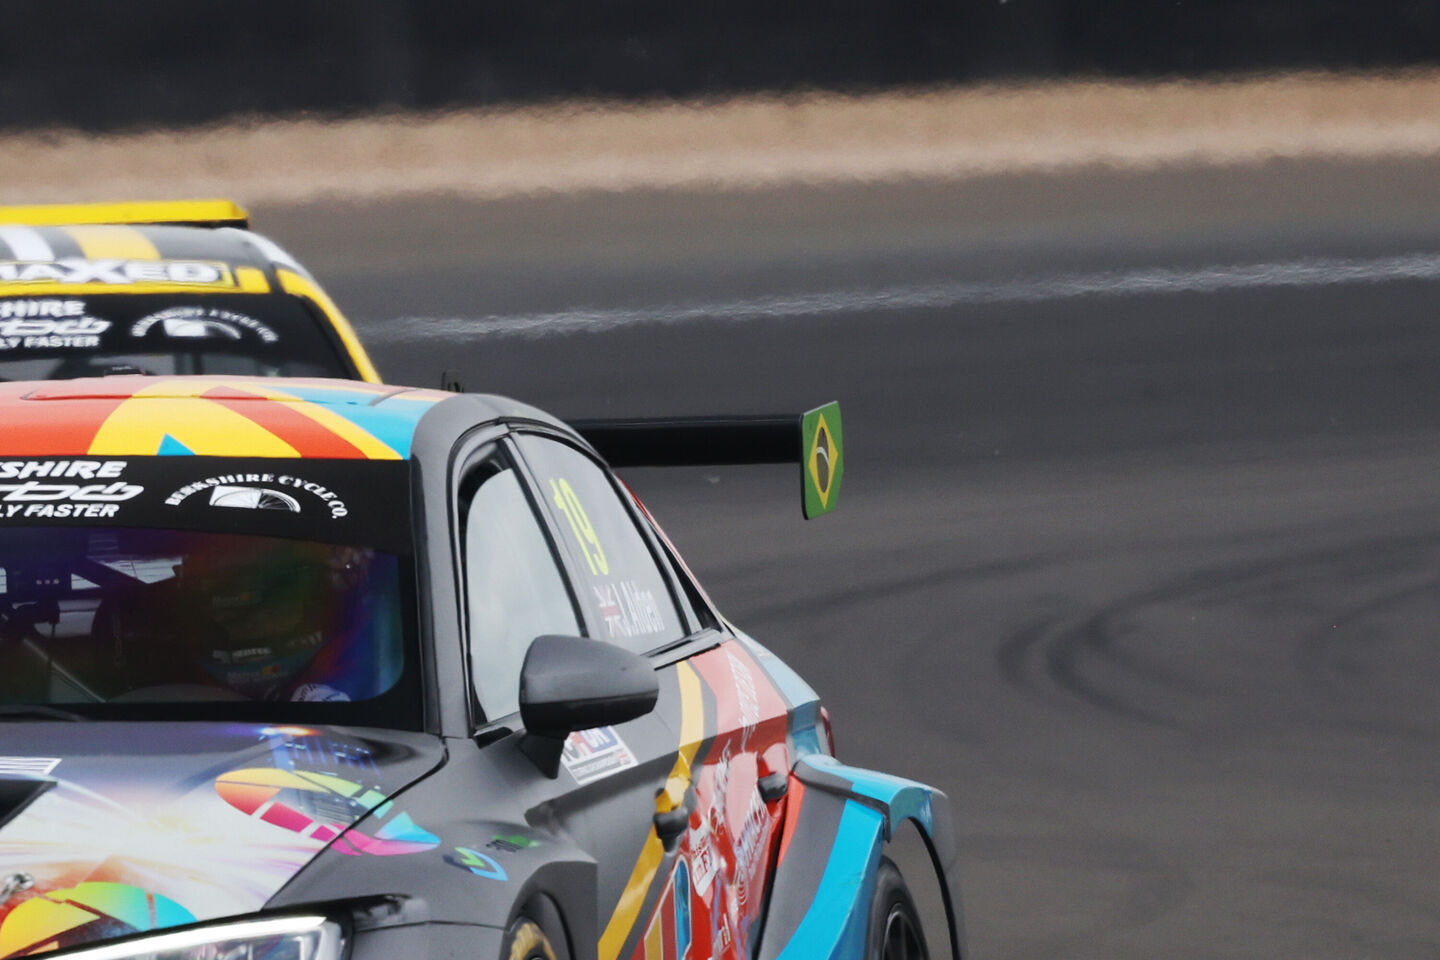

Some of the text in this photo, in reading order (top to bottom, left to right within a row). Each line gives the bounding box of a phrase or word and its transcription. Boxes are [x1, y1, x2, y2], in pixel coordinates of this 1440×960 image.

[24, 334, 101, 349] FASTER
[164, 473, 275, 507] BERKSHIRE
[278, 475, 338, 502] CYCLE
[24, 503, 120, 518] FASTER
